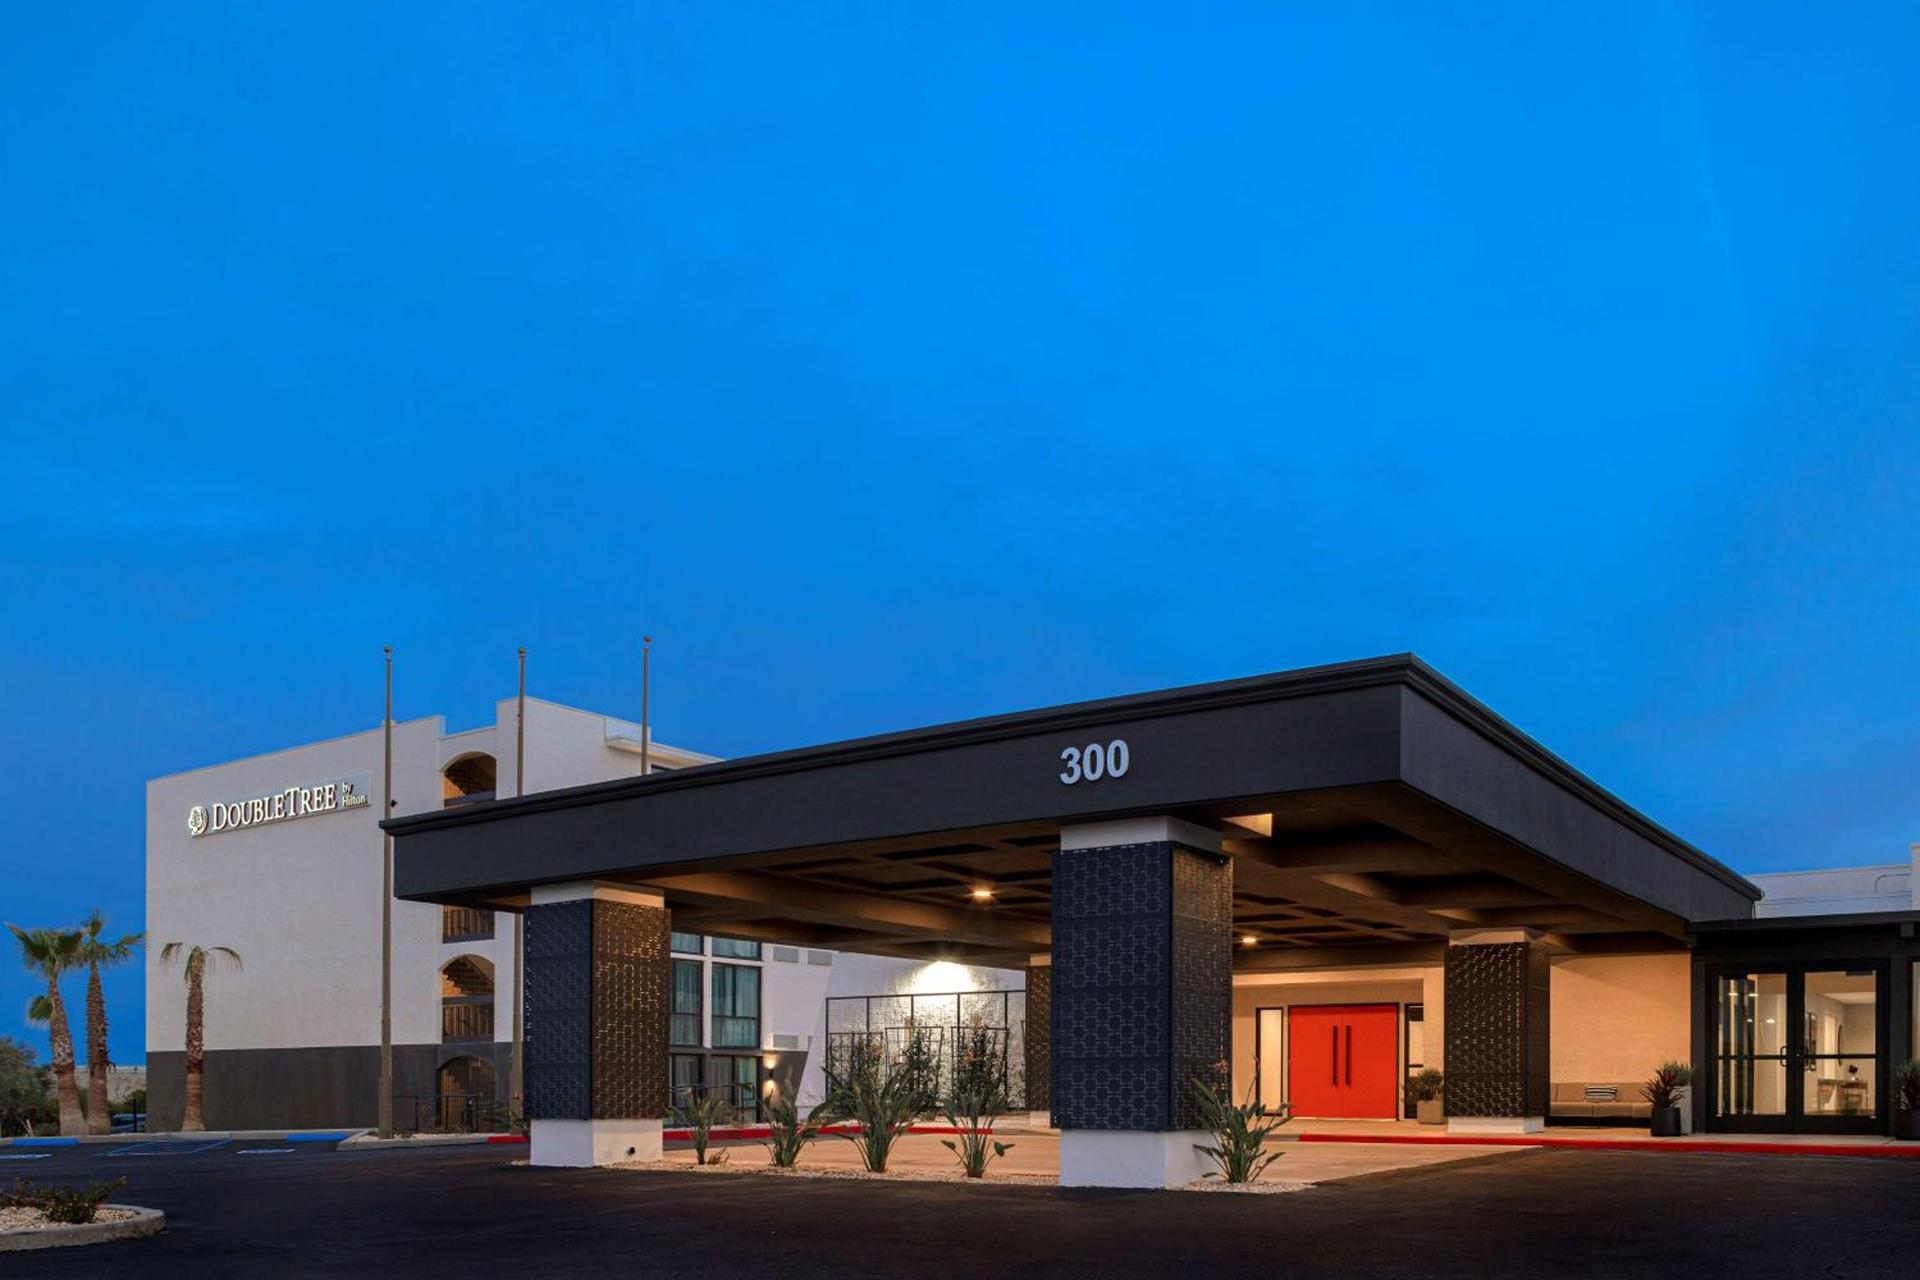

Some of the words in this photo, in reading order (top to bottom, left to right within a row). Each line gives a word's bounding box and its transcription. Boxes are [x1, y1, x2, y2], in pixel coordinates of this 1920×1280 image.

[1060, 739, 1129, 785] 300
[342, 781, 354, 795] by
[342, 794, 367, 807] Hilton
